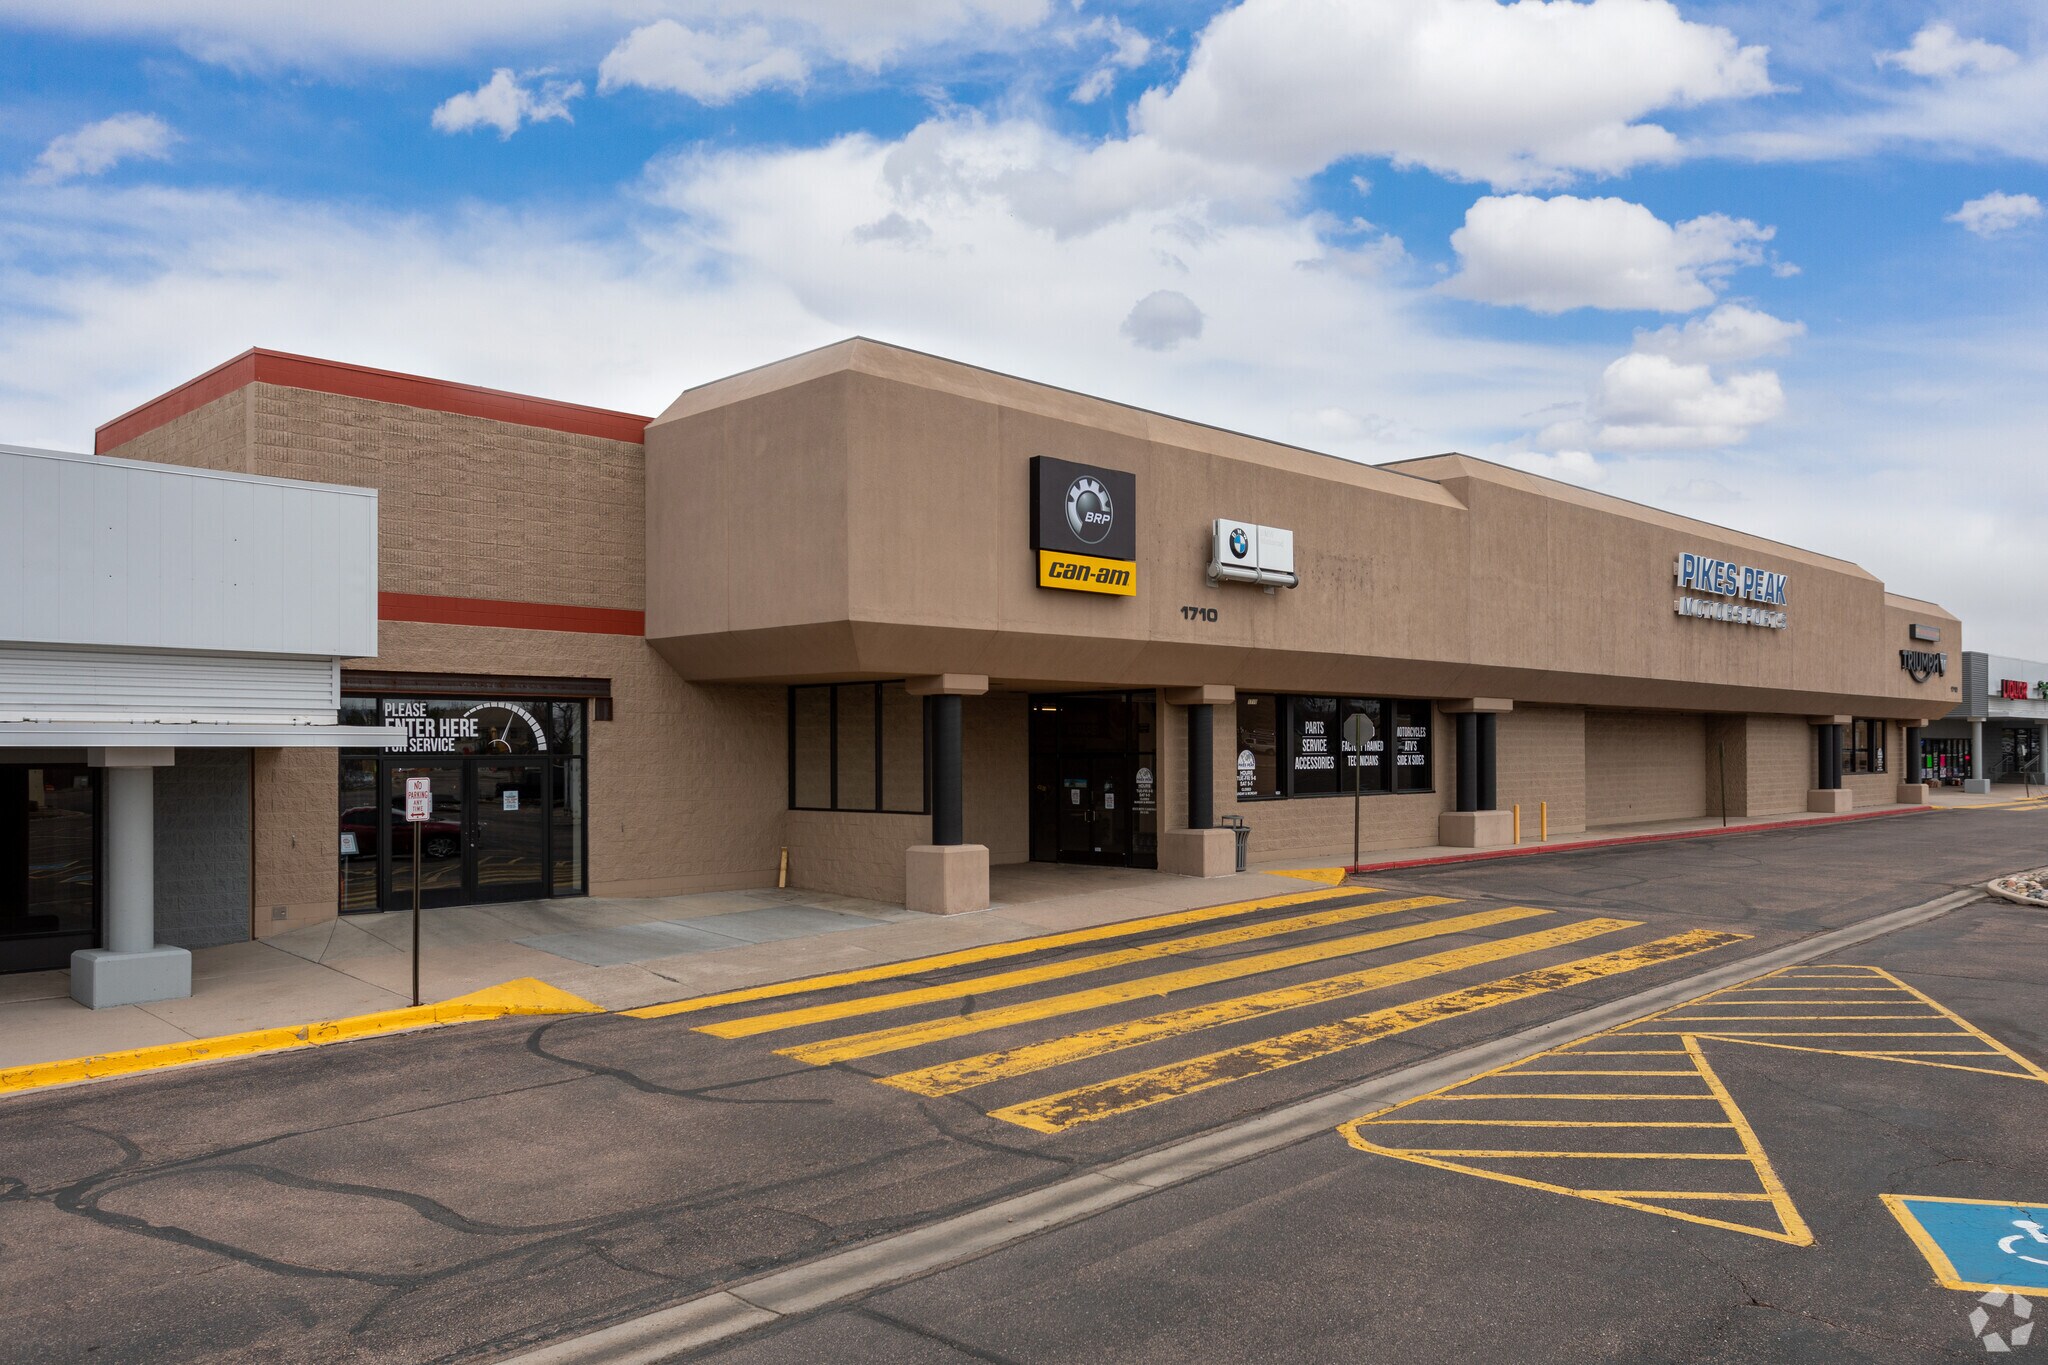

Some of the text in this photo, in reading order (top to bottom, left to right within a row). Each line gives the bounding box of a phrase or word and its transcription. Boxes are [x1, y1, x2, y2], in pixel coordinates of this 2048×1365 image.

[1085, 511, 1110, 525] BRP
[1049, 560, 1130, 586] can-am
[1678, 552, 1788, 606] PIKES PEAK
[1181, 605, 1218, 622] 1710
[1679, 596, 1788, 630] MOTORSPORTS
[1900, 650, 1940, 682] TRIUMPH
[2001, 679, 2028, 700] LIQUOR
[384, 702, 427, 717] PLEASE
[439, 718, 479, 738] HERE
[1305, 721, 1325, 734] PARTS
[409, 738, 455, 752] SERVICE
[1302, 738, 1327, 752] SERVICE
[1294, 756, 1335, 770] ACCESSORIES
[1347, 755, 1379, 767] TECNICIANS
[1397, 754, 1425, 766] SIDE X SIDES
[413, 781, 422, 790] NO
[408, 791, 428, 799] PARKING
